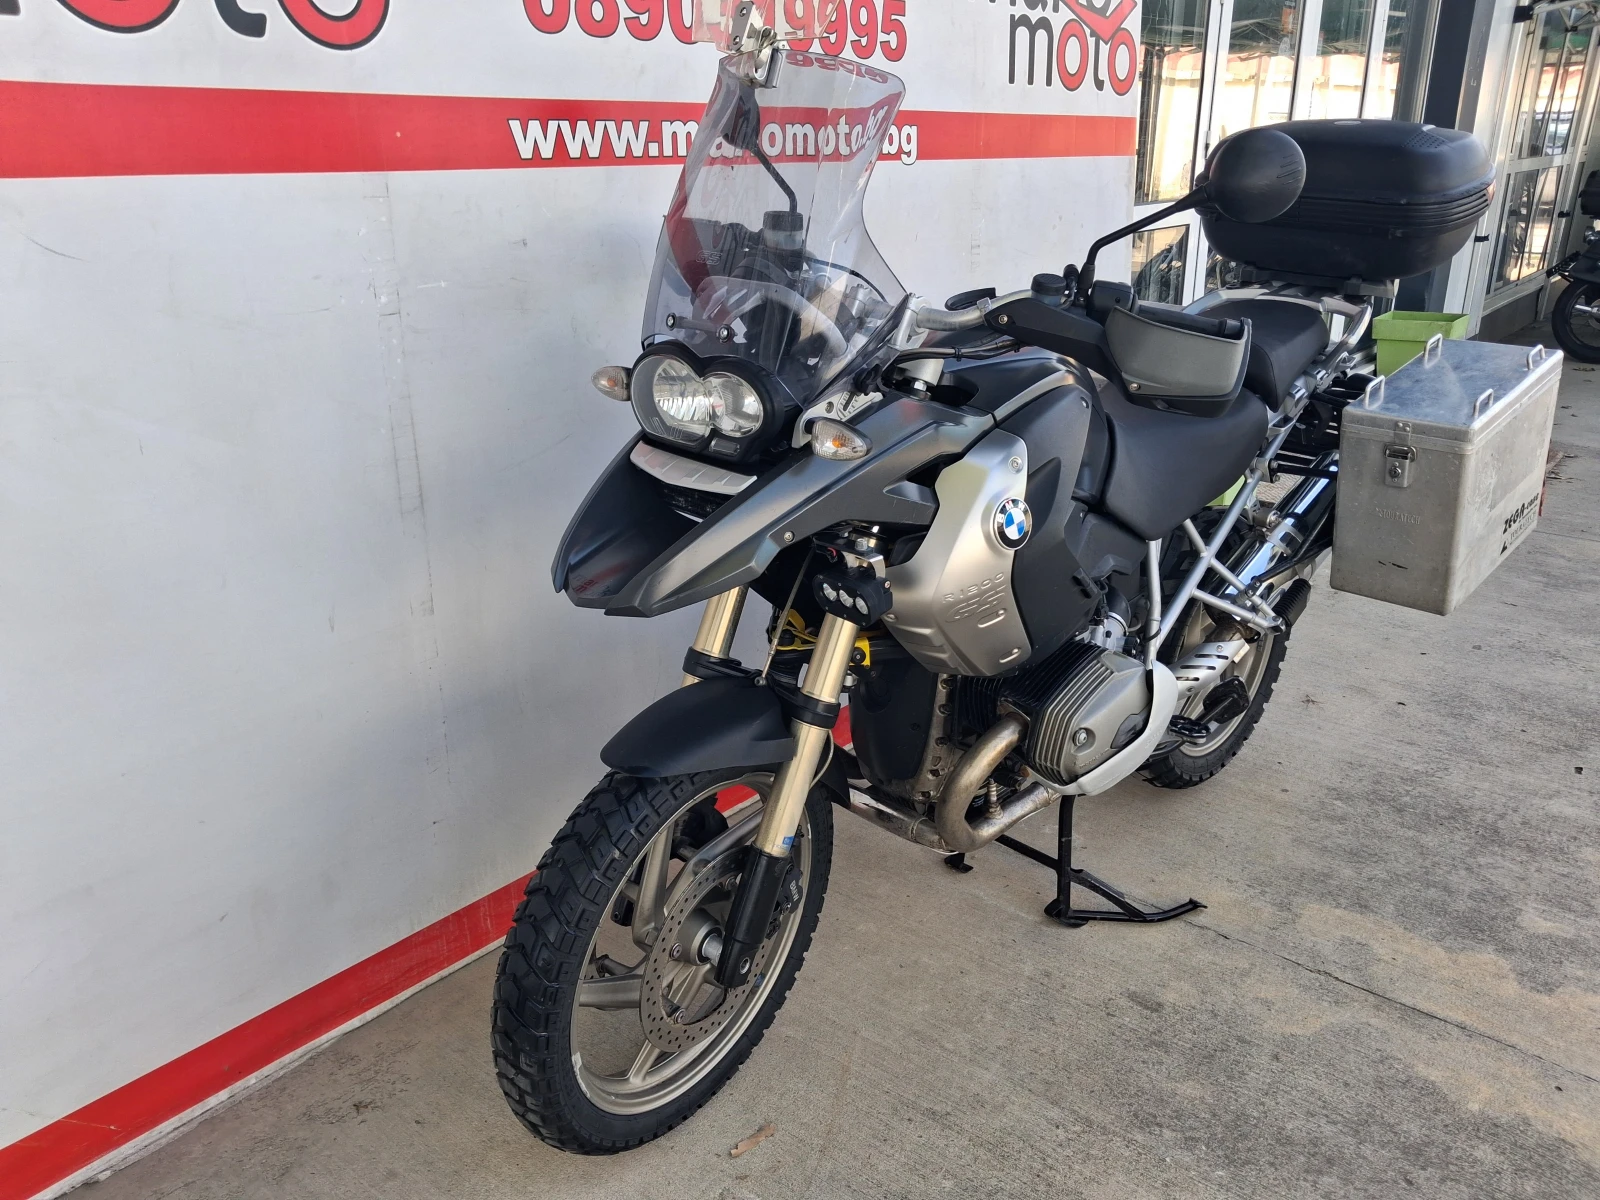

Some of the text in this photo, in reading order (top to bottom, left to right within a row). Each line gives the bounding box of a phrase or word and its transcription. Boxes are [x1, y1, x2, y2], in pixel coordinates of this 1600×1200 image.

[1008, 13, 1137, 96] moto
[507, 119, 918, 165] www.maomoto.bg
[696, 250, 722, 266] GS
[942, 572, 1005, 604] R1200
[945, 584, 1007, 623] GS
[789, 879, 800, 902] BMW
